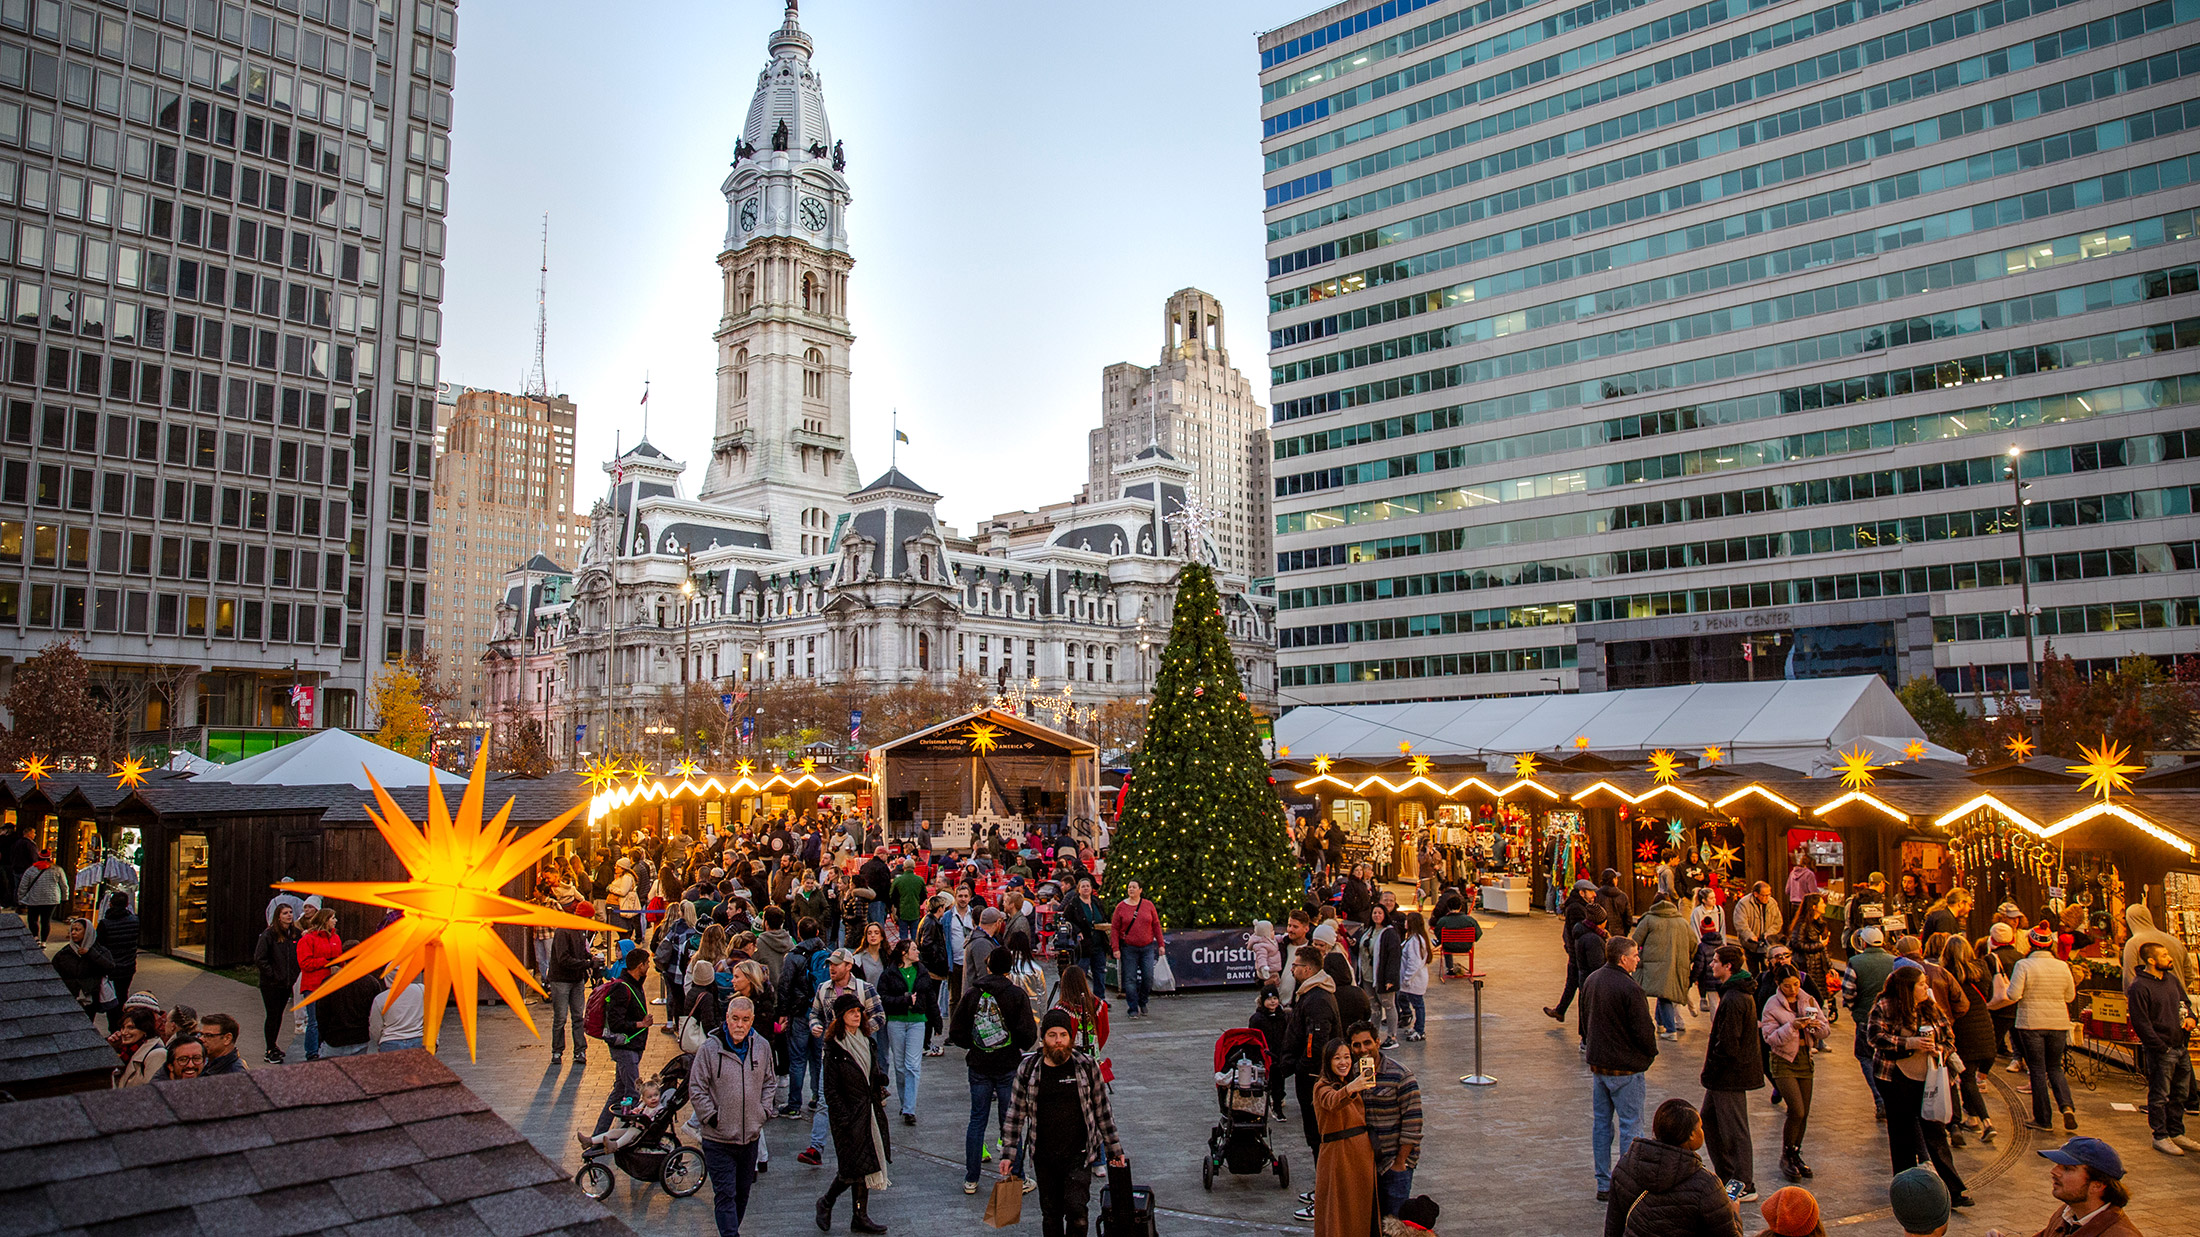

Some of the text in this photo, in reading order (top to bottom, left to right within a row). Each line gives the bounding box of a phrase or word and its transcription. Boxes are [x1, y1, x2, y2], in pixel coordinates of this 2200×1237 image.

[1692, 612, 1791, 630] 2 PENN CENTER
